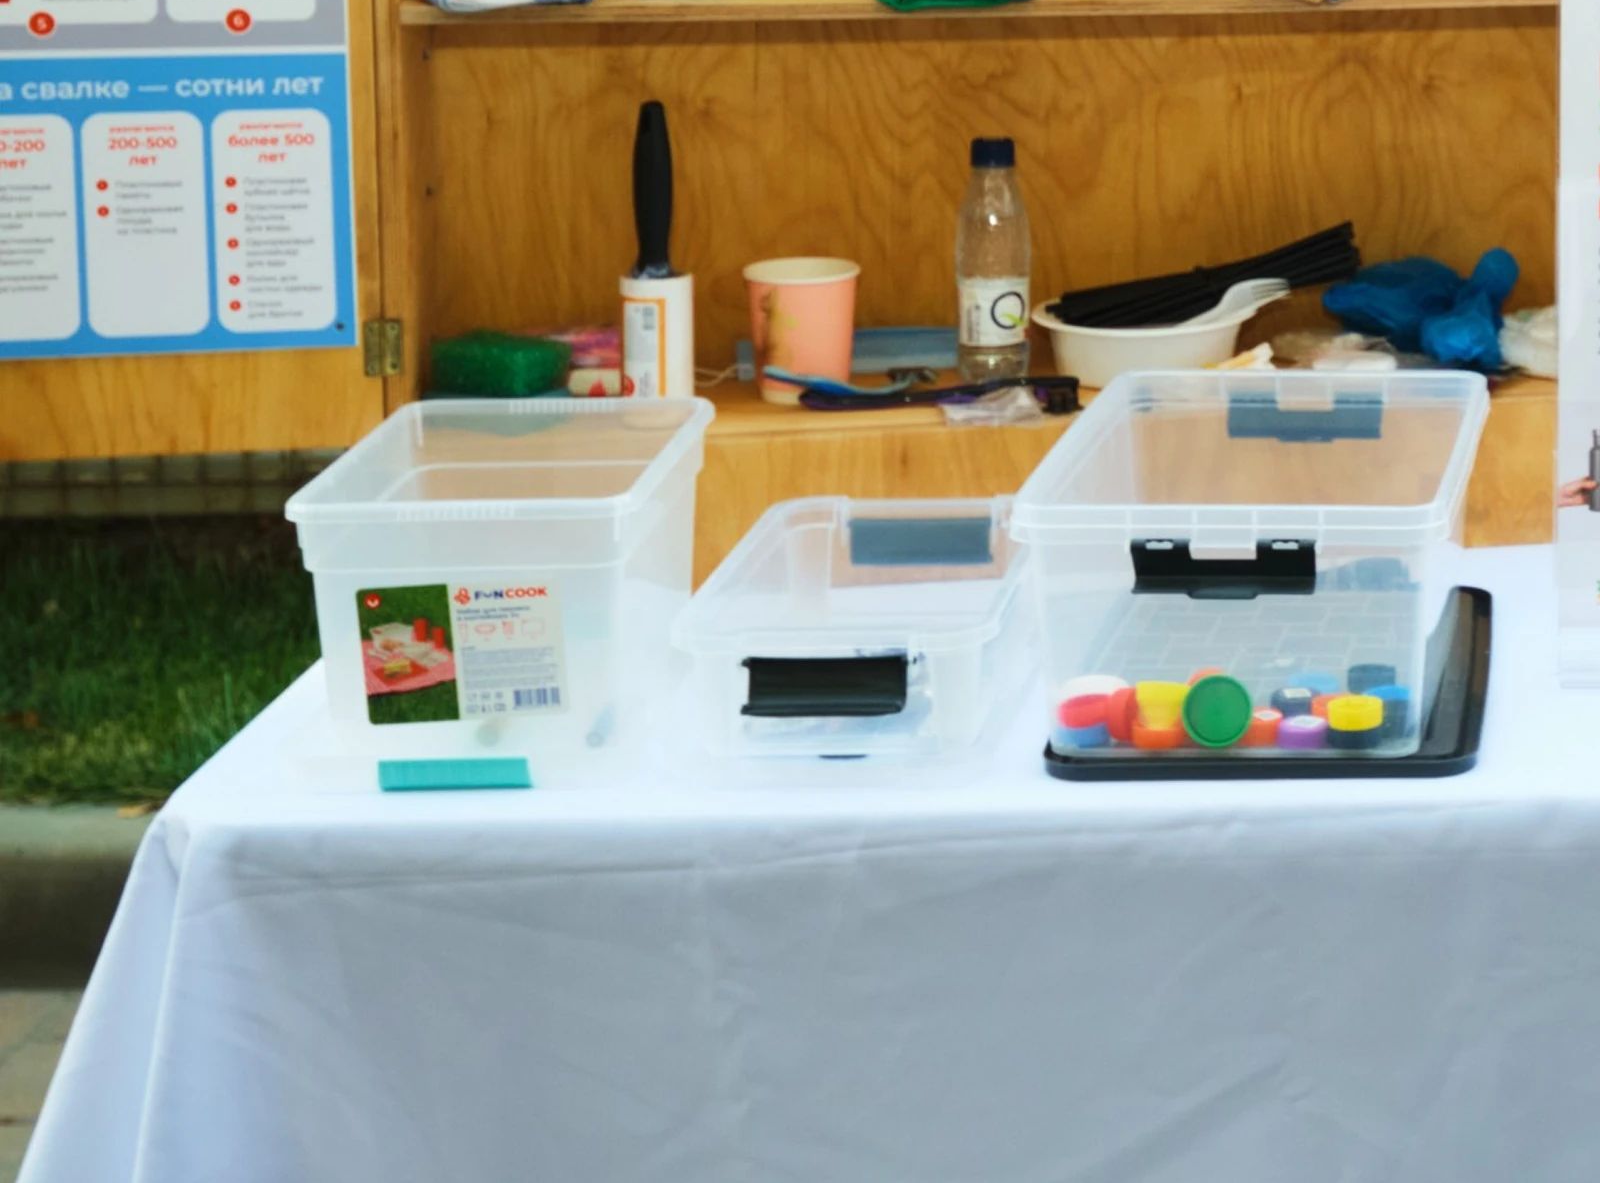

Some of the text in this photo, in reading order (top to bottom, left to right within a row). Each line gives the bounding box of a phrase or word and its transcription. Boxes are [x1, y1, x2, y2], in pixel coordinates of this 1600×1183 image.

[21, 78, 130, 101] свалке
[175, 76, 265, 98] сотни
[272, 74, 324, 96] лет
[228, 133, 315, 147] более 500
[129, 156, 157, 167] лет
[258, 152, 287, 163] лет
